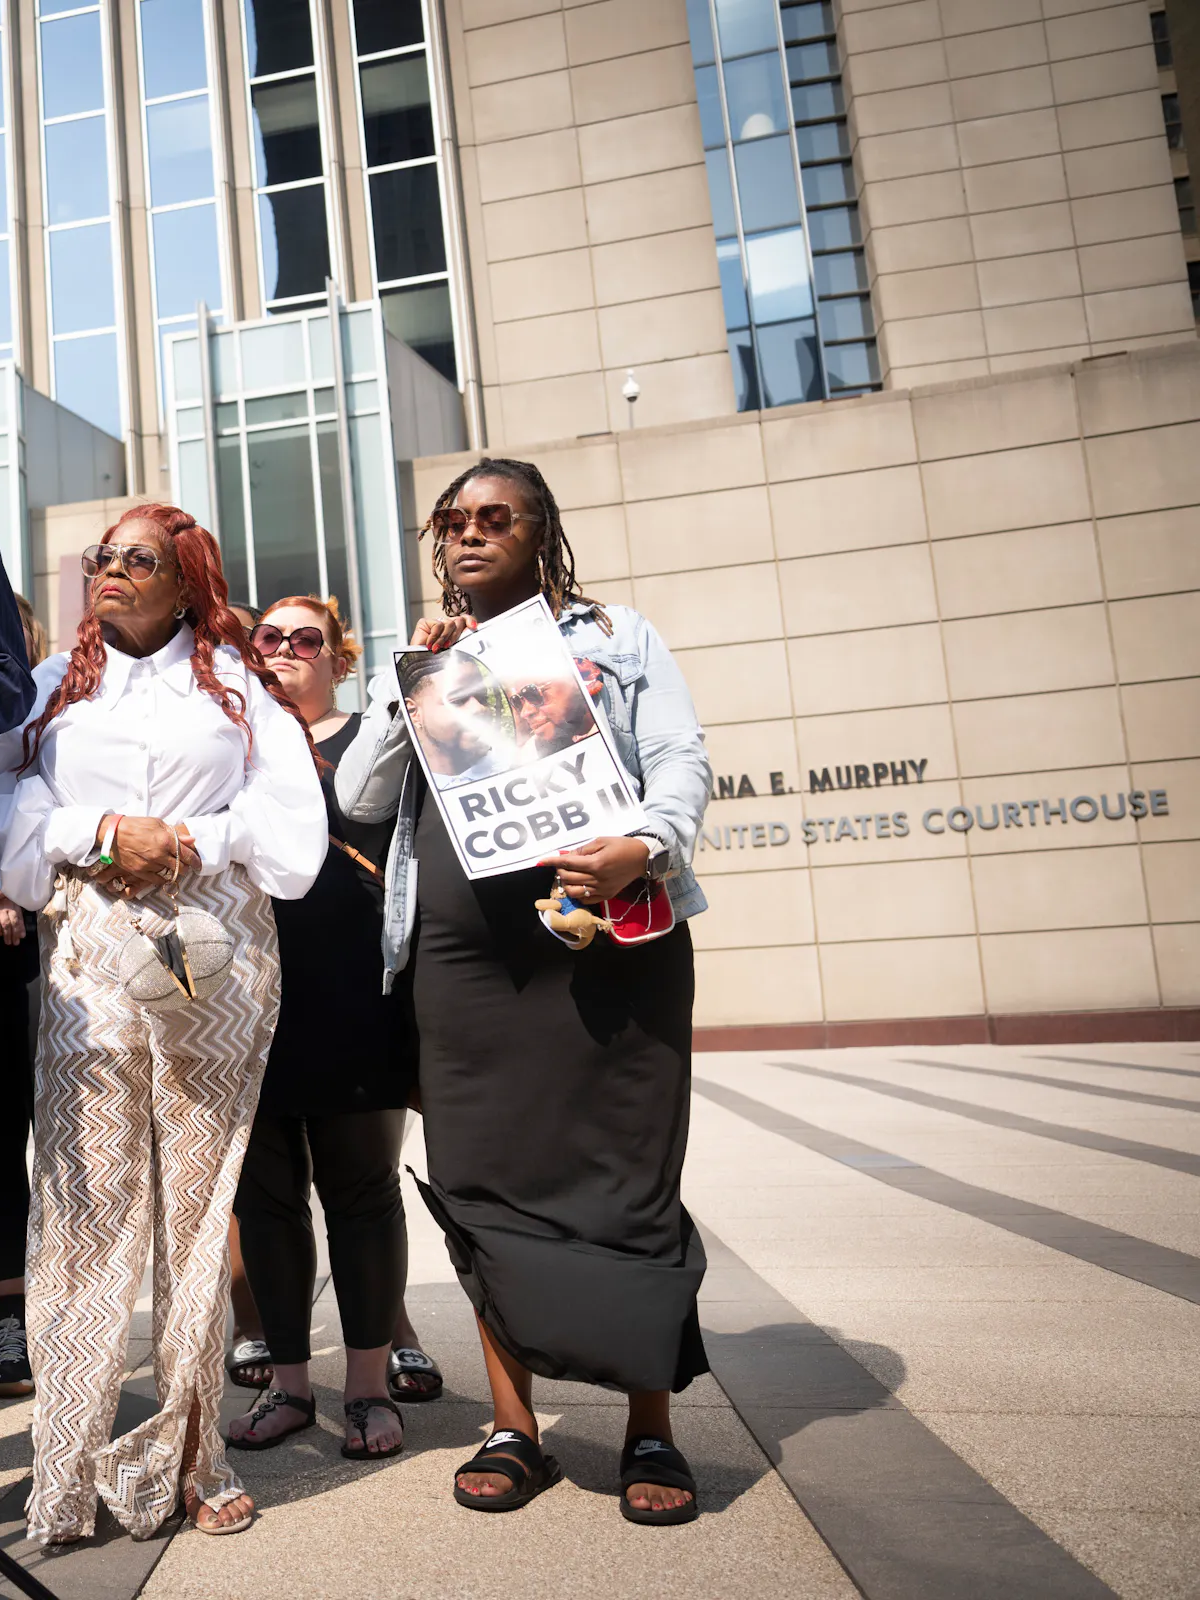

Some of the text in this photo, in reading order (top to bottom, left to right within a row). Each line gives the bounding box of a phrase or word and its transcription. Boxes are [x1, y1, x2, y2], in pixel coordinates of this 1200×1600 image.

[458, 752, 586, 822] RICKY
[770, 771, 794, 796] E.
[809, 758, 928, 794] MURPHY
[465, 800, 590, 858] COBB
[801, 812, 910, 844] STATES
[922, 789, 1170, 834] COURTHOUSE
[639, 1439, 662, 1449] NIKE
